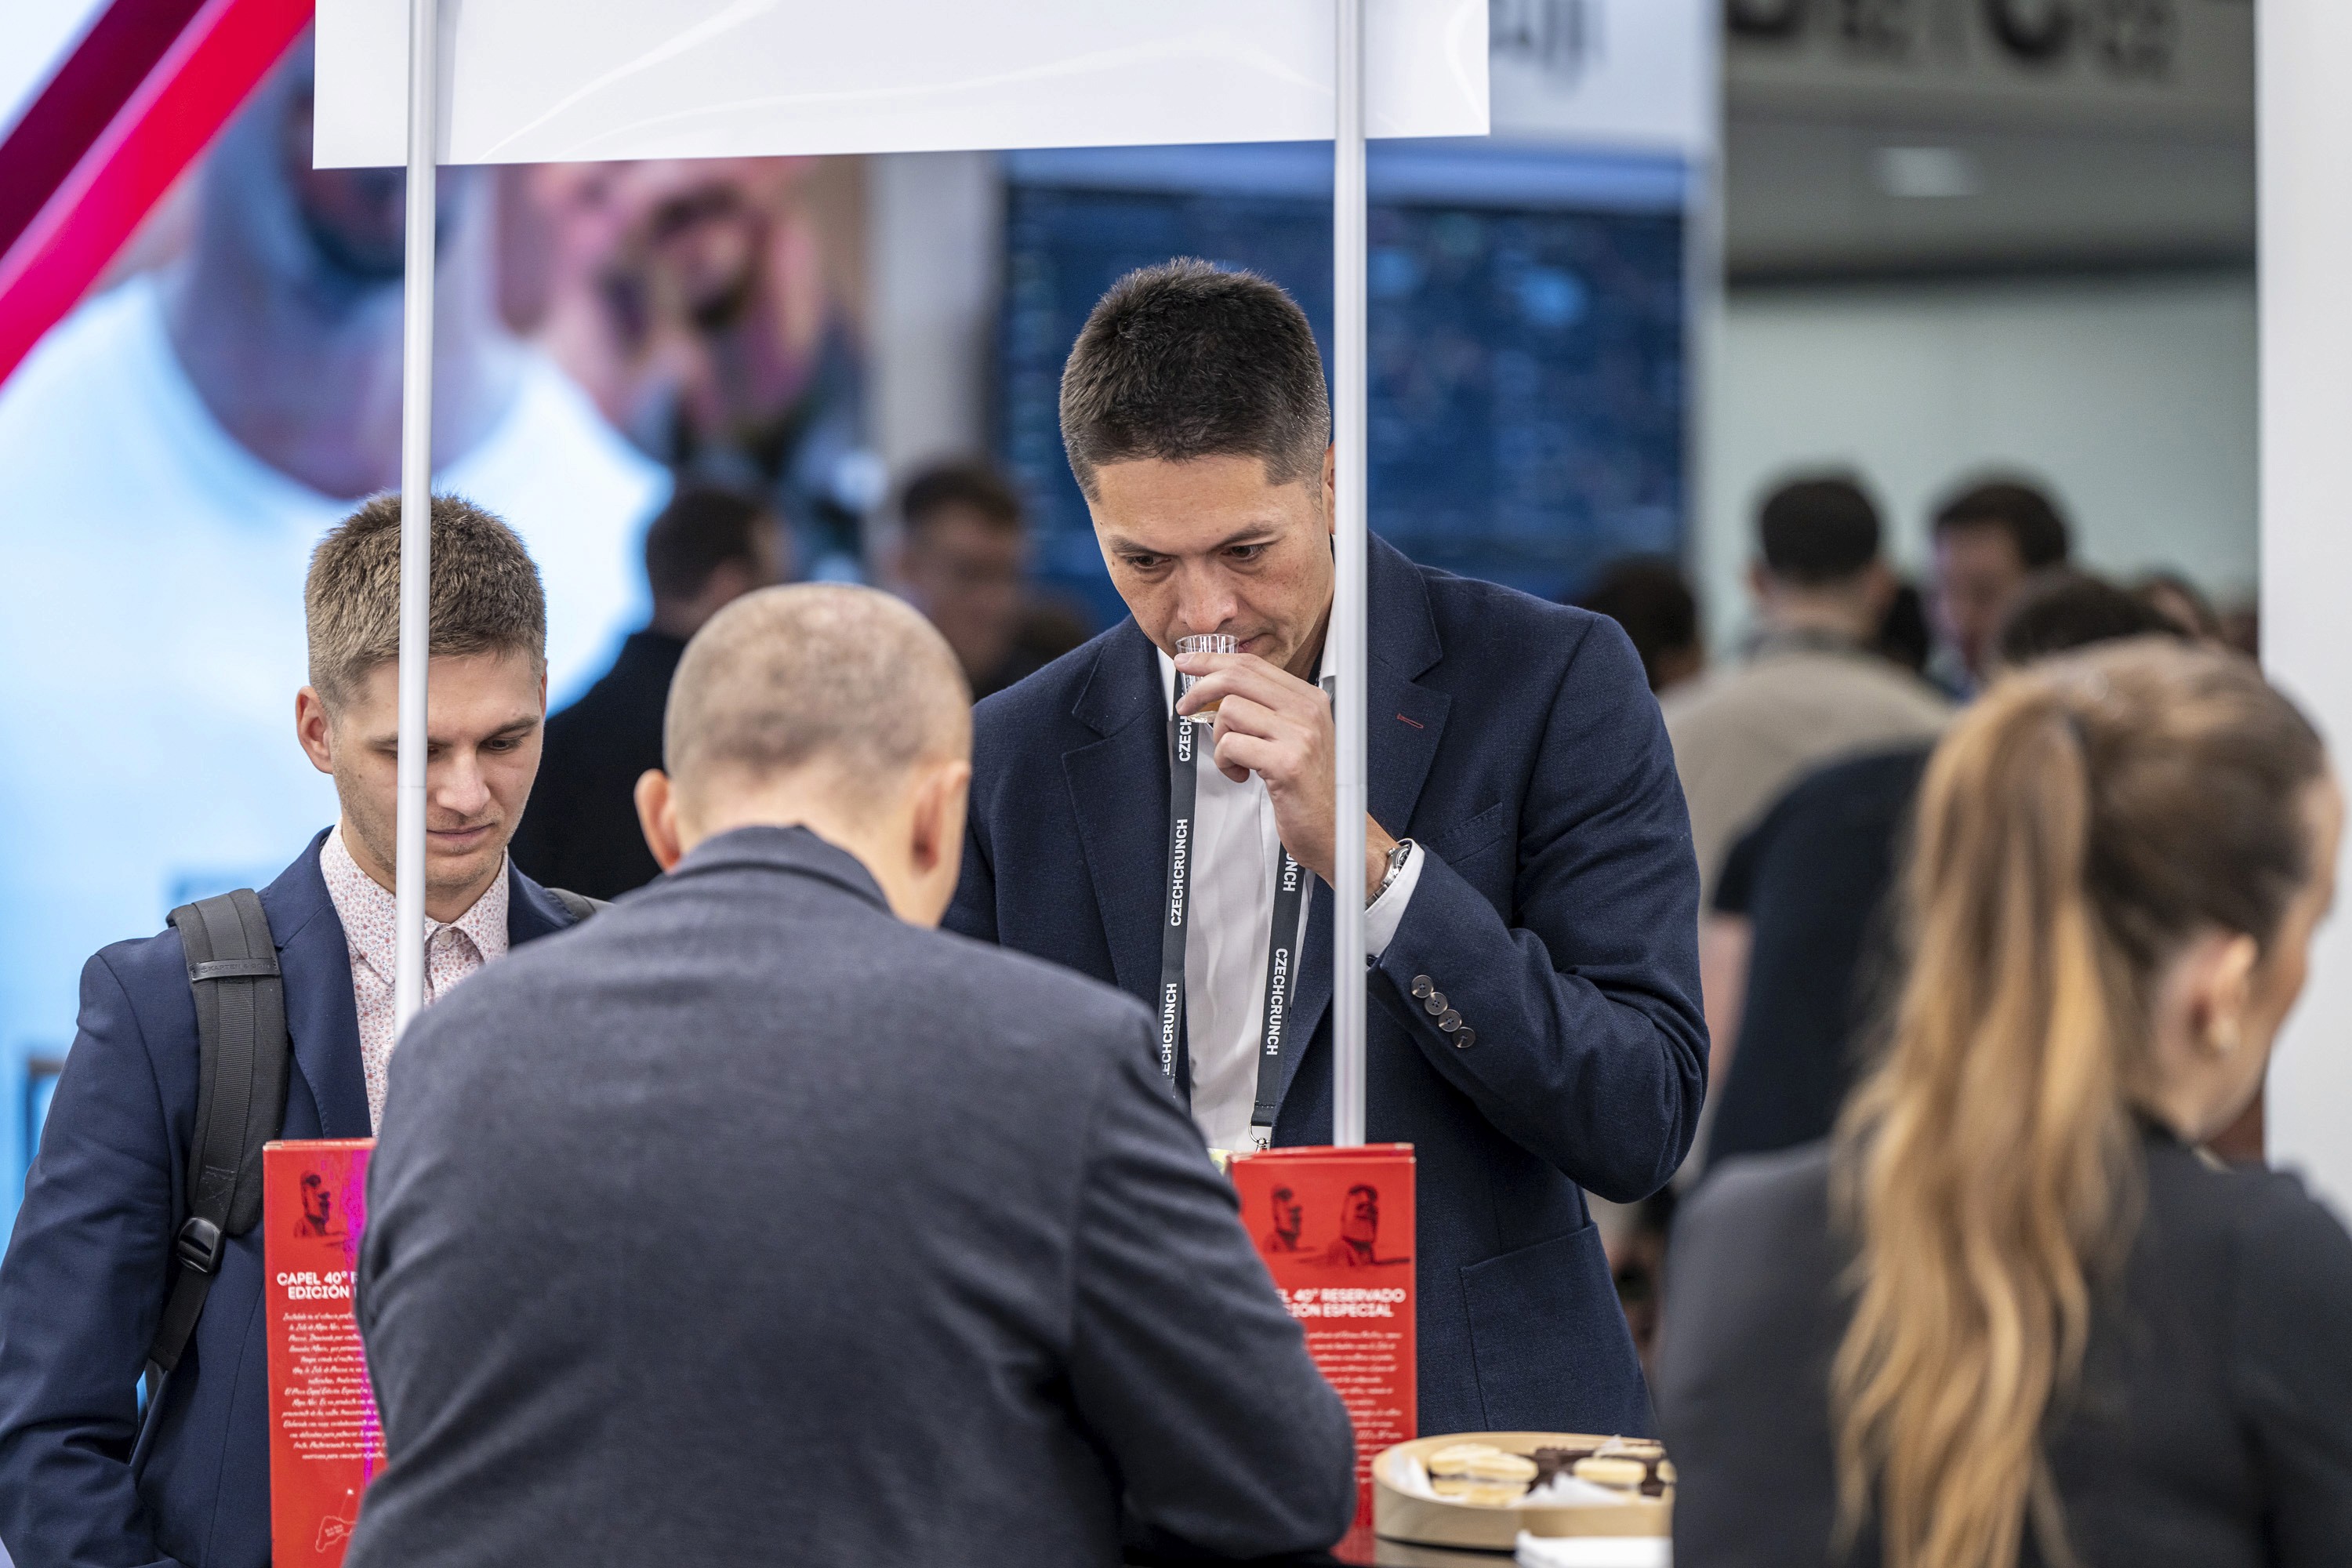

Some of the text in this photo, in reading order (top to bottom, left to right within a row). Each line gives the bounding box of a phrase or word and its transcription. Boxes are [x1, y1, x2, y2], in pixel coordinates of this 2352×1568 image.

[1171, 818, 1188, 927] CZECHCRUNCH
[1266, 948, 1288, 1056] CZECHCRUNCH
[1162, 983, 1178, 1076] ECHCRUNCH
[277, 1272, 321, 1286] CAPEL
[288, 1284, 350, 1300] EDICIÓN
[1320, 1287, 1406, 1304] RESERVADO
[1323, 1302, 1395, 1318] ESPECIAL
